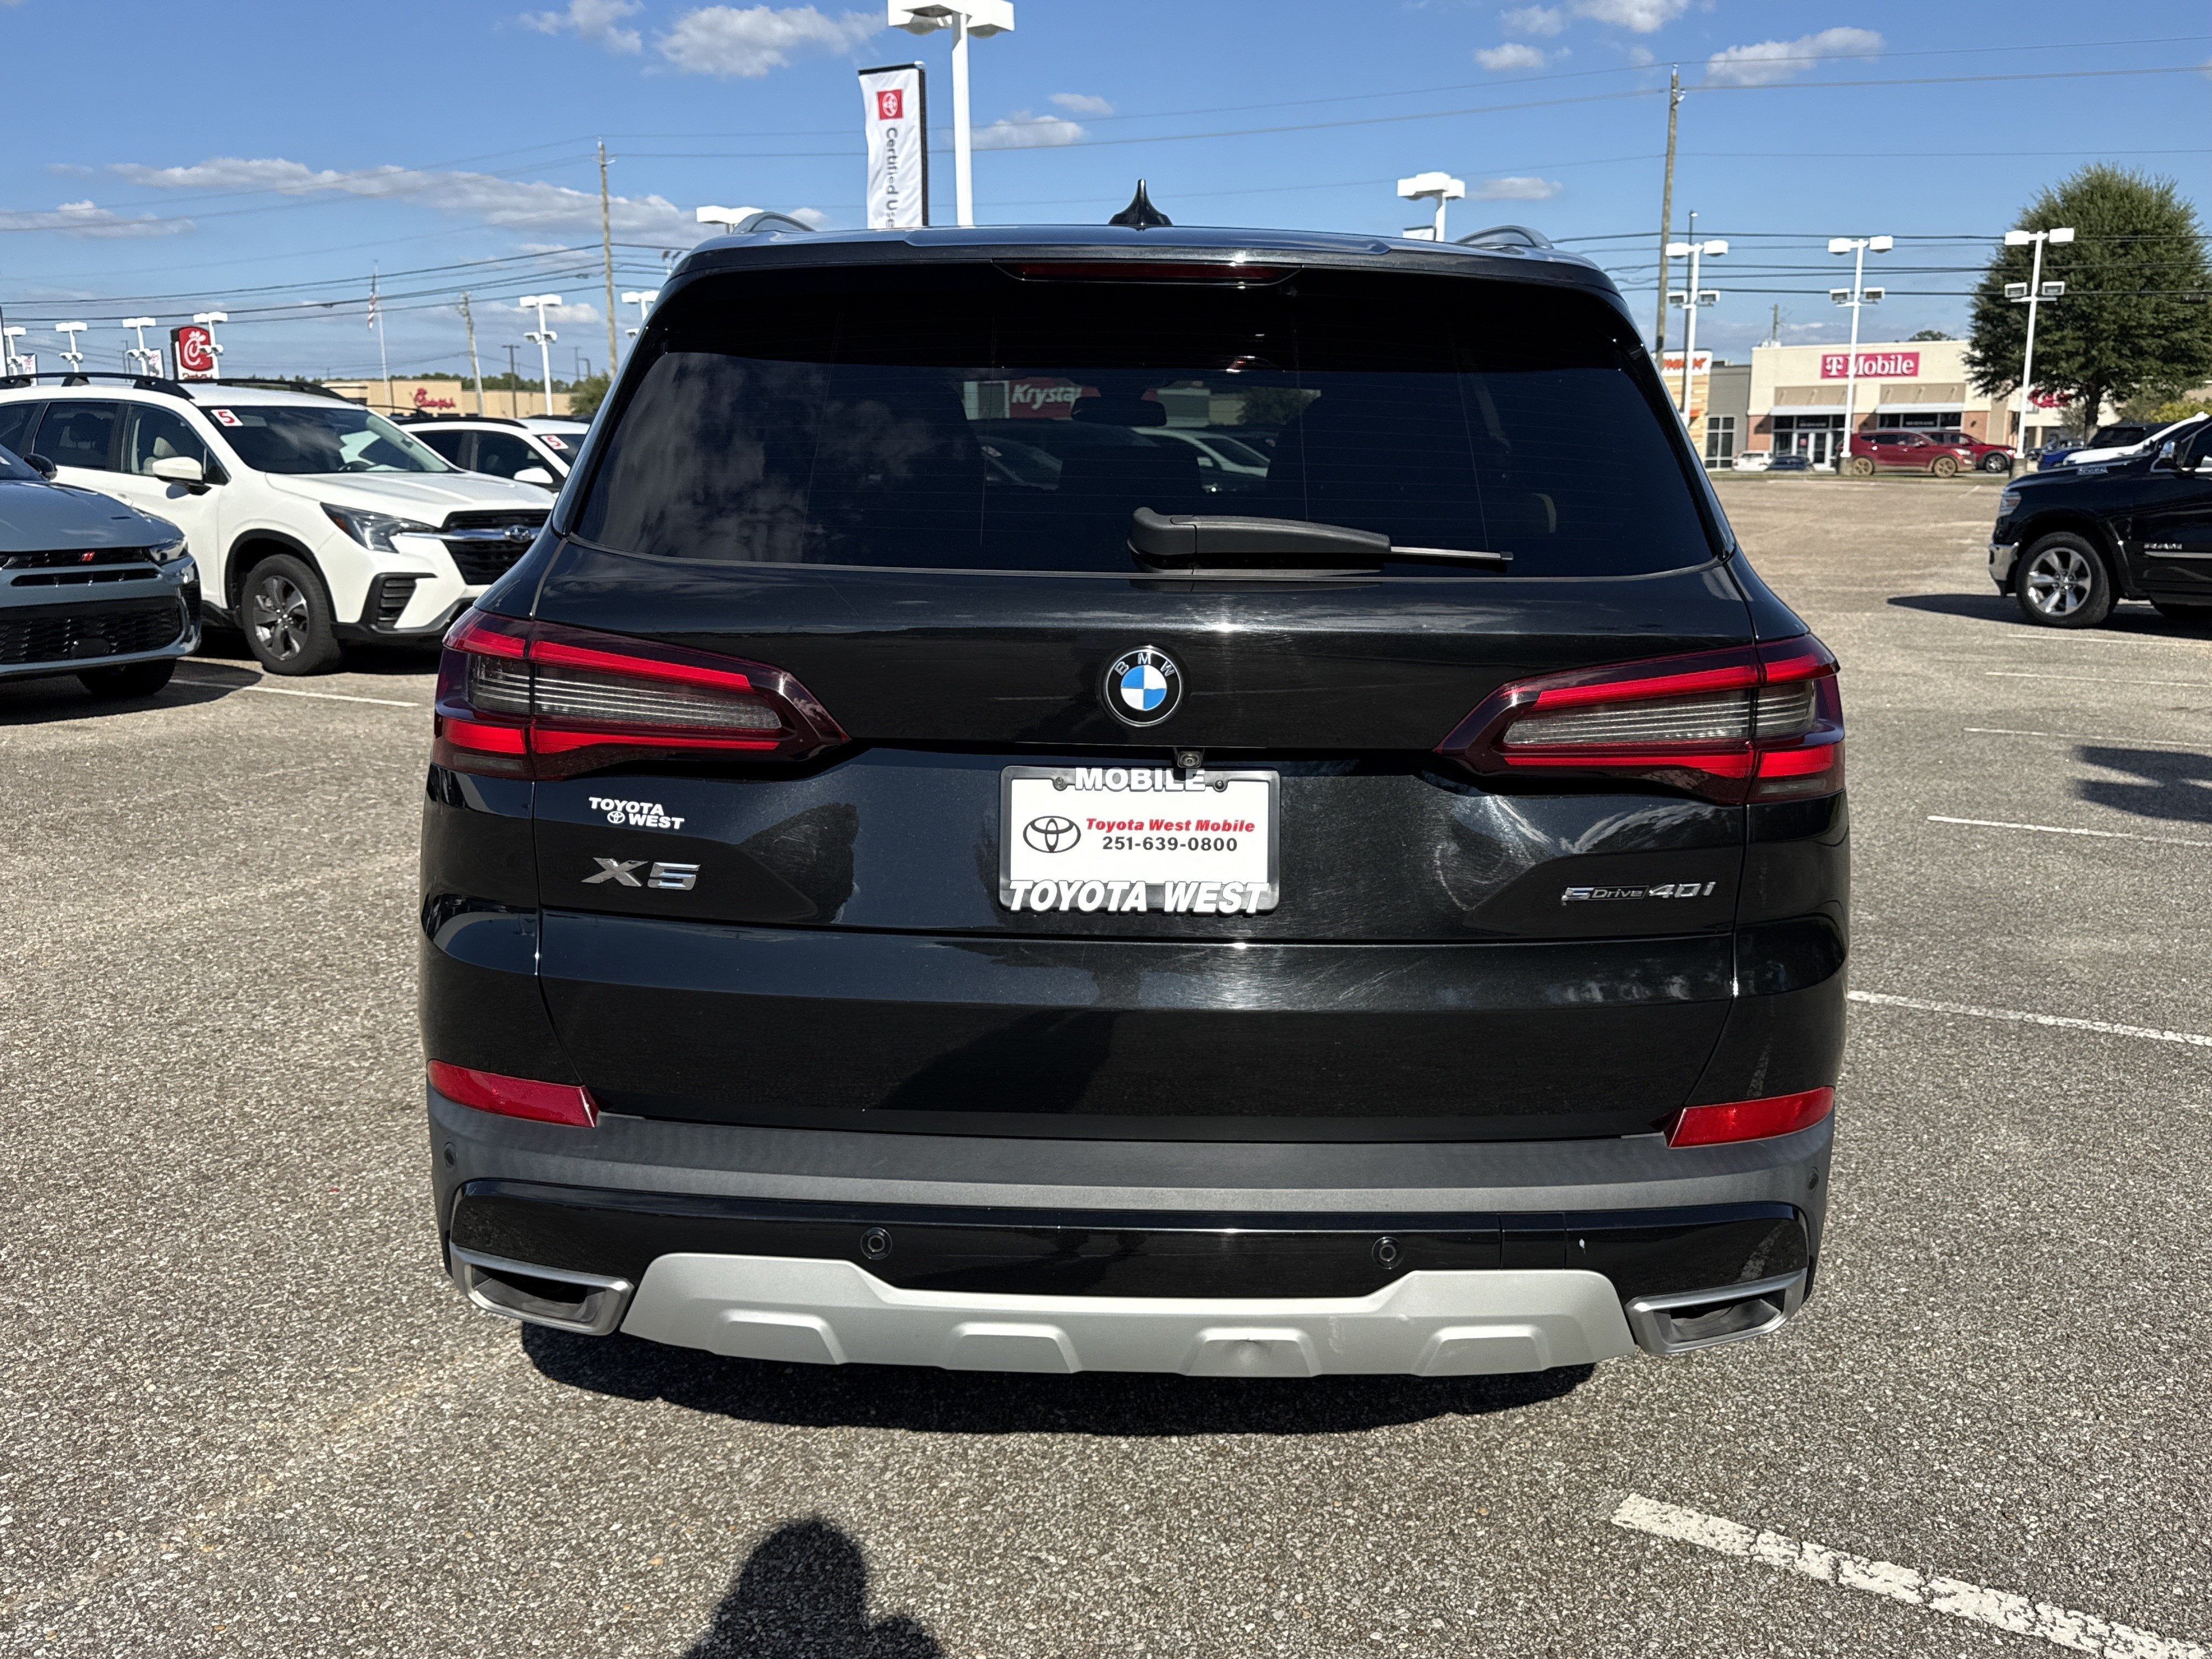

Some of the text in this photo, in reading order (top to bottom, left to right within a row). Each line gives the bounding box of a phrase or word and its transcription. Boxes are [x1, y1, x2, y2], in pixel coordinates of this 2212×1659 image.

[886, 127, 899, 194] Certified
[1846, 354, 1915, 376] Mobile
[218, 411, 235, 424] 5
[1114, 652, 1175, 677] BMW
[1075, 768, 1206, 791] MOBILE
[589, 797, 664, 816] TOYOTA
[629, 813, 685, 830] WEST
[1086, 818, 1256, 832] Toyota West Mobile
[1102, 836, 1238, 851] 251-639-0800
[580, 857, 701, 890] X5
[1009, 879, 1269, 913] TOYOTA WEST
